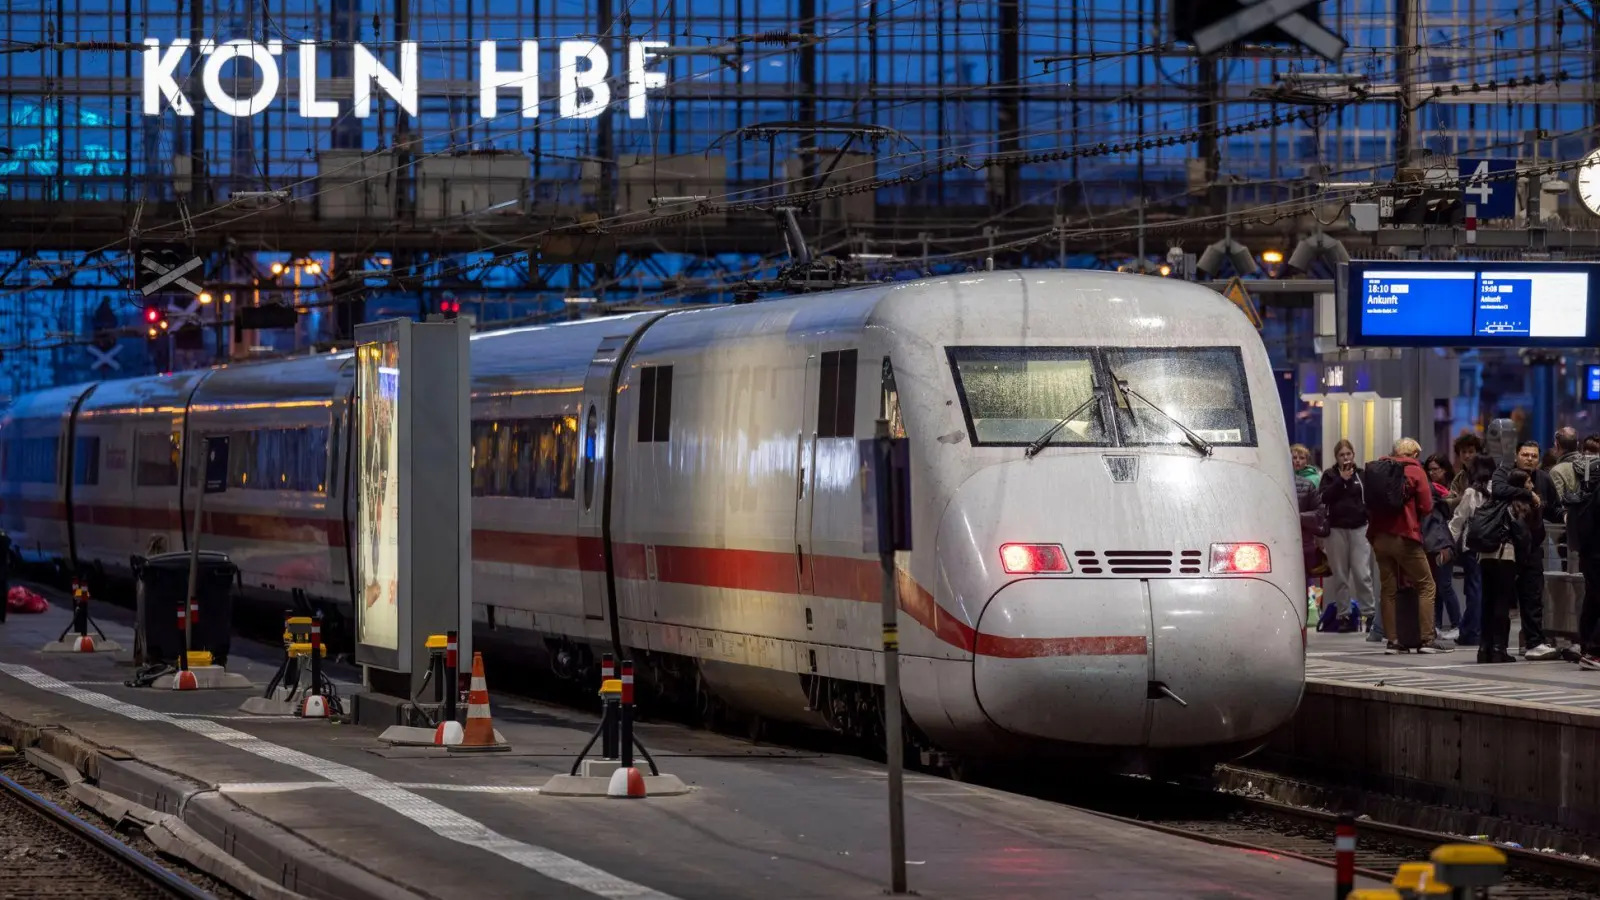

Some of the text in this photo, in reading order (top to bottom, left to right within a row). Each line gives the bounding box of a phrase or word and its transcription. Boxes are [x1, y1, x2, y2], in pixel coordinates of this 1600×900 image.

[143, 38, 669, 119] KÖLN HBF
[1465, 160, 1494, 205] 4
[1367, 294, 1398, 304] Ankunft
[1368, 284, 1389, 293] 18:10
